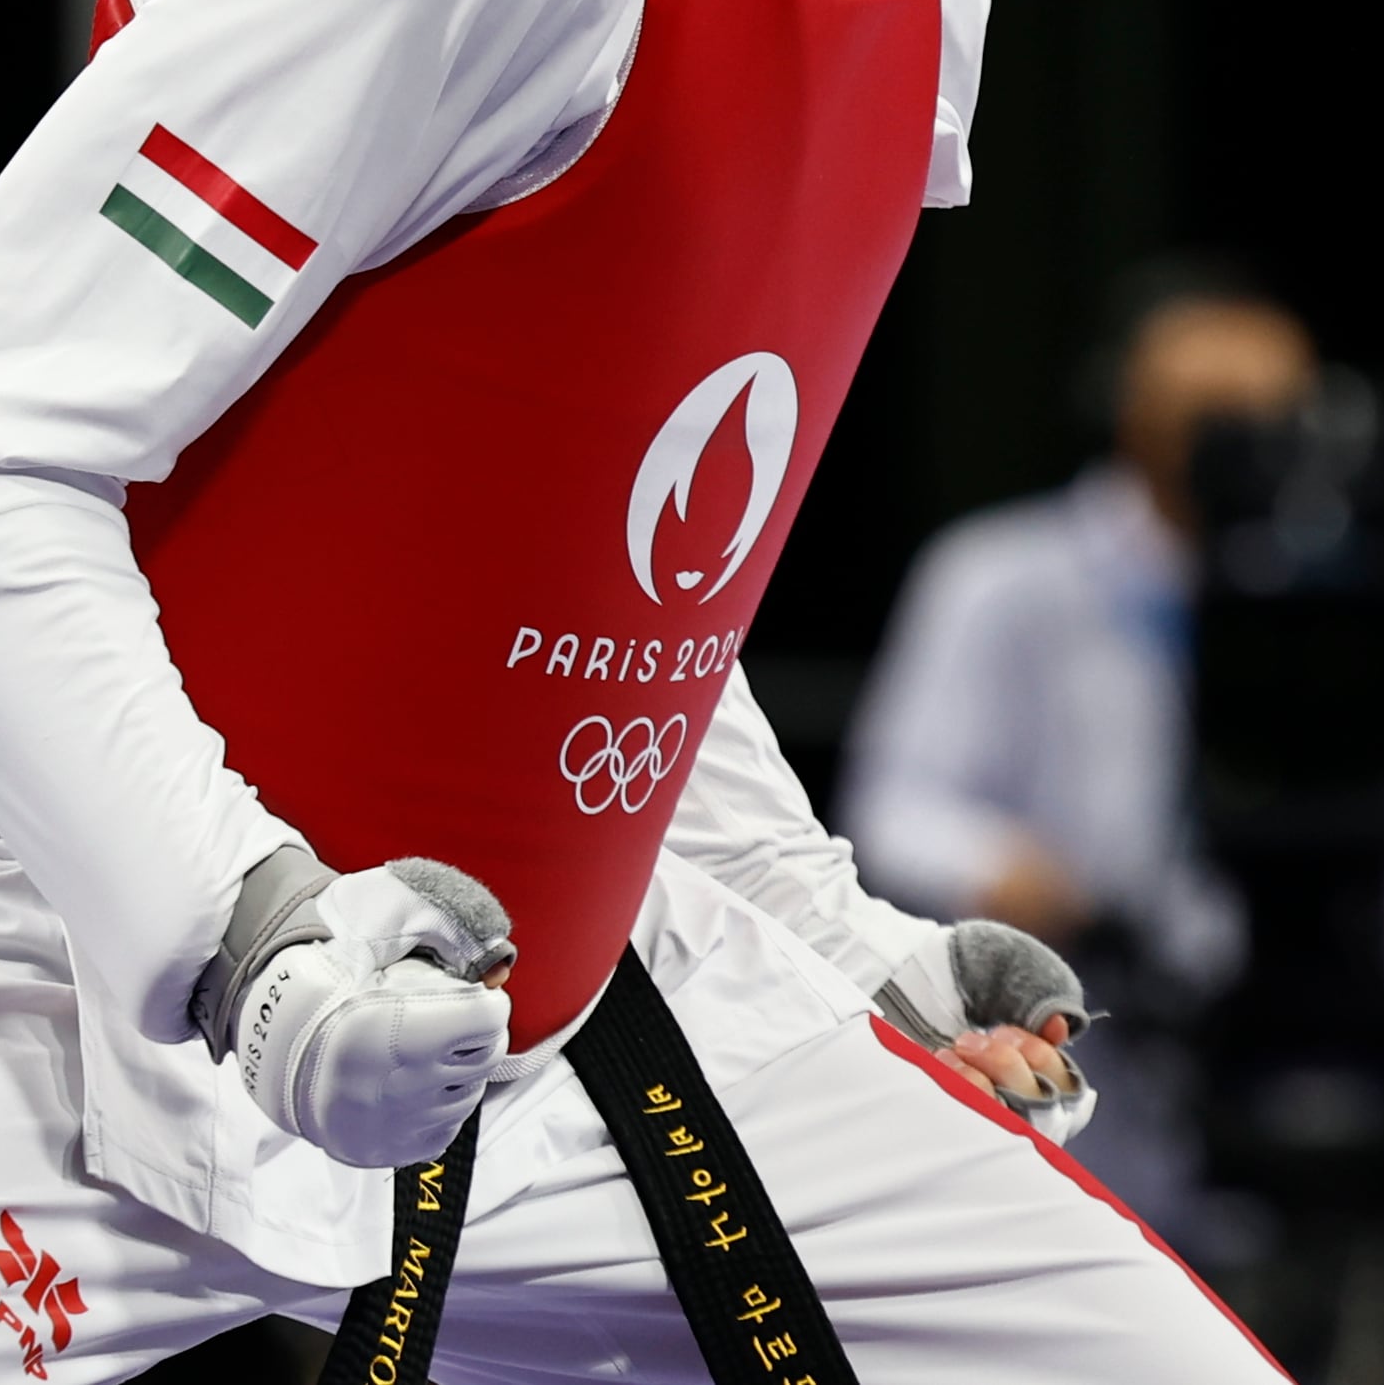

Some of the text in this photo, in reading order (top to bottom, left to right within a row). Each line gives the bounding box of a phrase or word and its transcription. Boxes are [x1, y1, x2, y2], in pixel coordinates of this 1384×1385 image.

[245, 969, 291, 1103] ARiS 2024
[642, 1083, 817, 1385] 비비아나 마르
